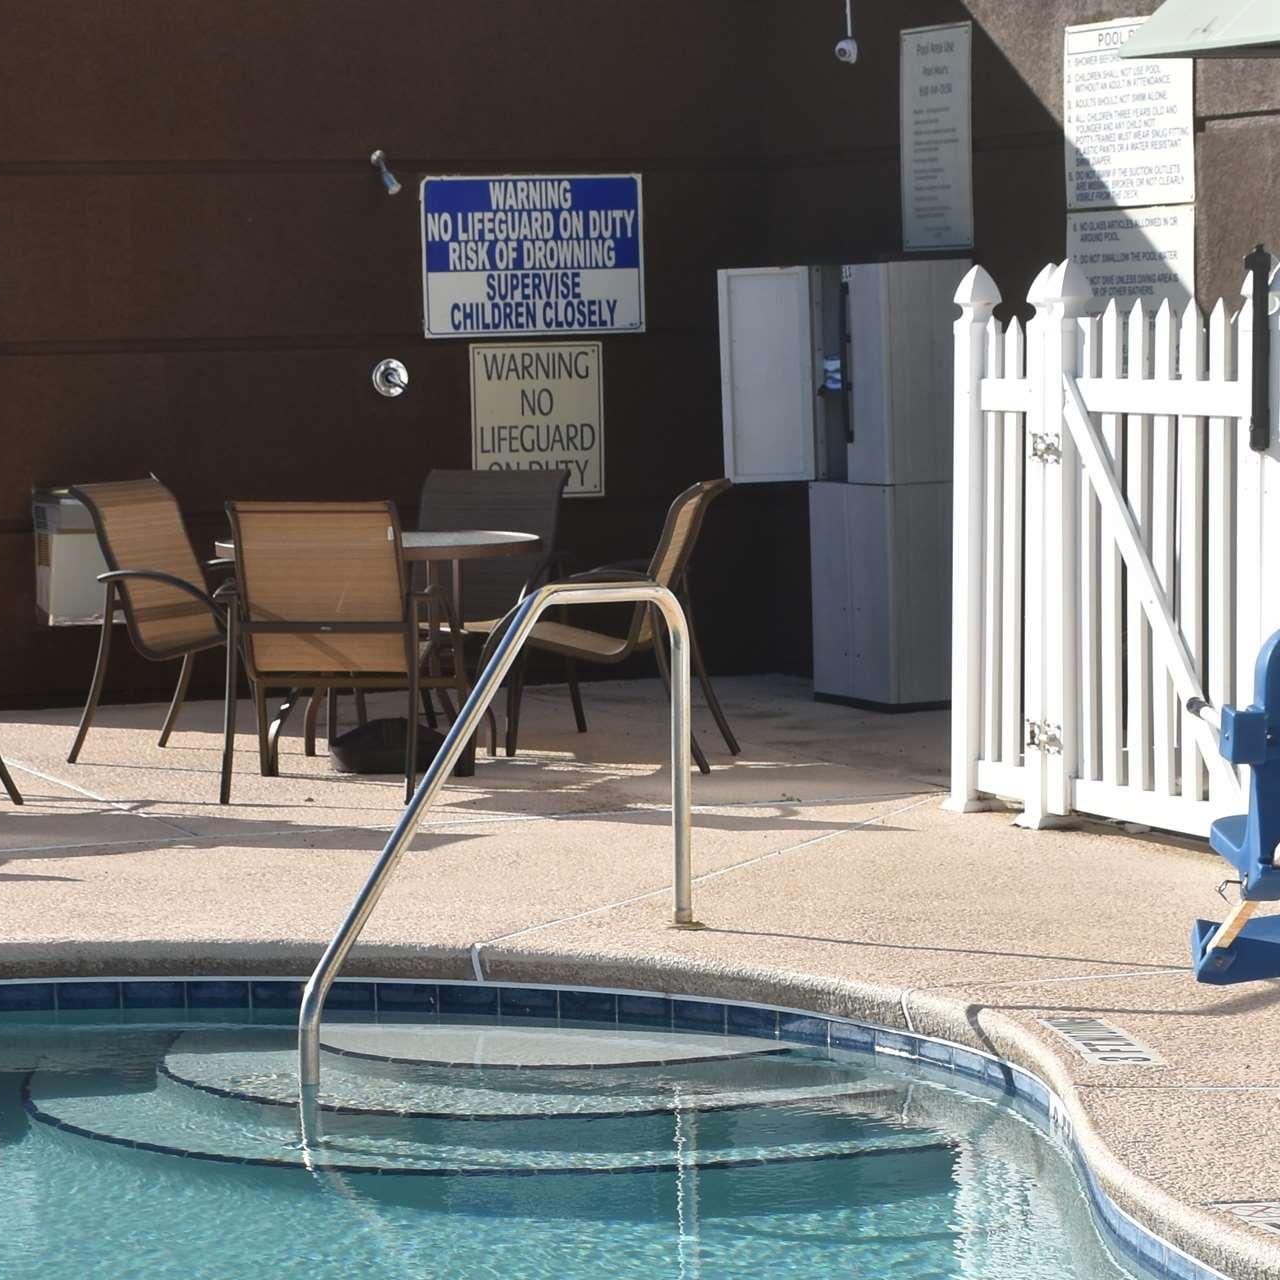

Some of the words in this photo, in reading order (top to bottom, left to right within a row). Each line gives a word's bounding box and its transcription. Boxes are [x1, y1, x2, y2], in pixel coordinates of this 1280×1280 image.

[1098, 32, 1124, 46] POOL
[489, 181, 572, 210] WARNING
[427, 212, 452, 241] NO
[457, 211, 553, 240] LIFEGUARD
[559, 210, 584, 239] ON
[589, 209, 635, 238] DUTY
[449, 241, 490, 271] RISK
[495, 241, 517, 269] OF
[523, 239, 616, 269] DROWNING
[486, 272, 581, 301] SUPERVISE
[450, 300, 536, 331] CHILDREN
[543, 299, 618, 329] CLOSELY
[483, 351, 590, 381] WARNING
[521, 388, 554, 416] NO
[480, 423, 596, 454] LIFEGUARD
